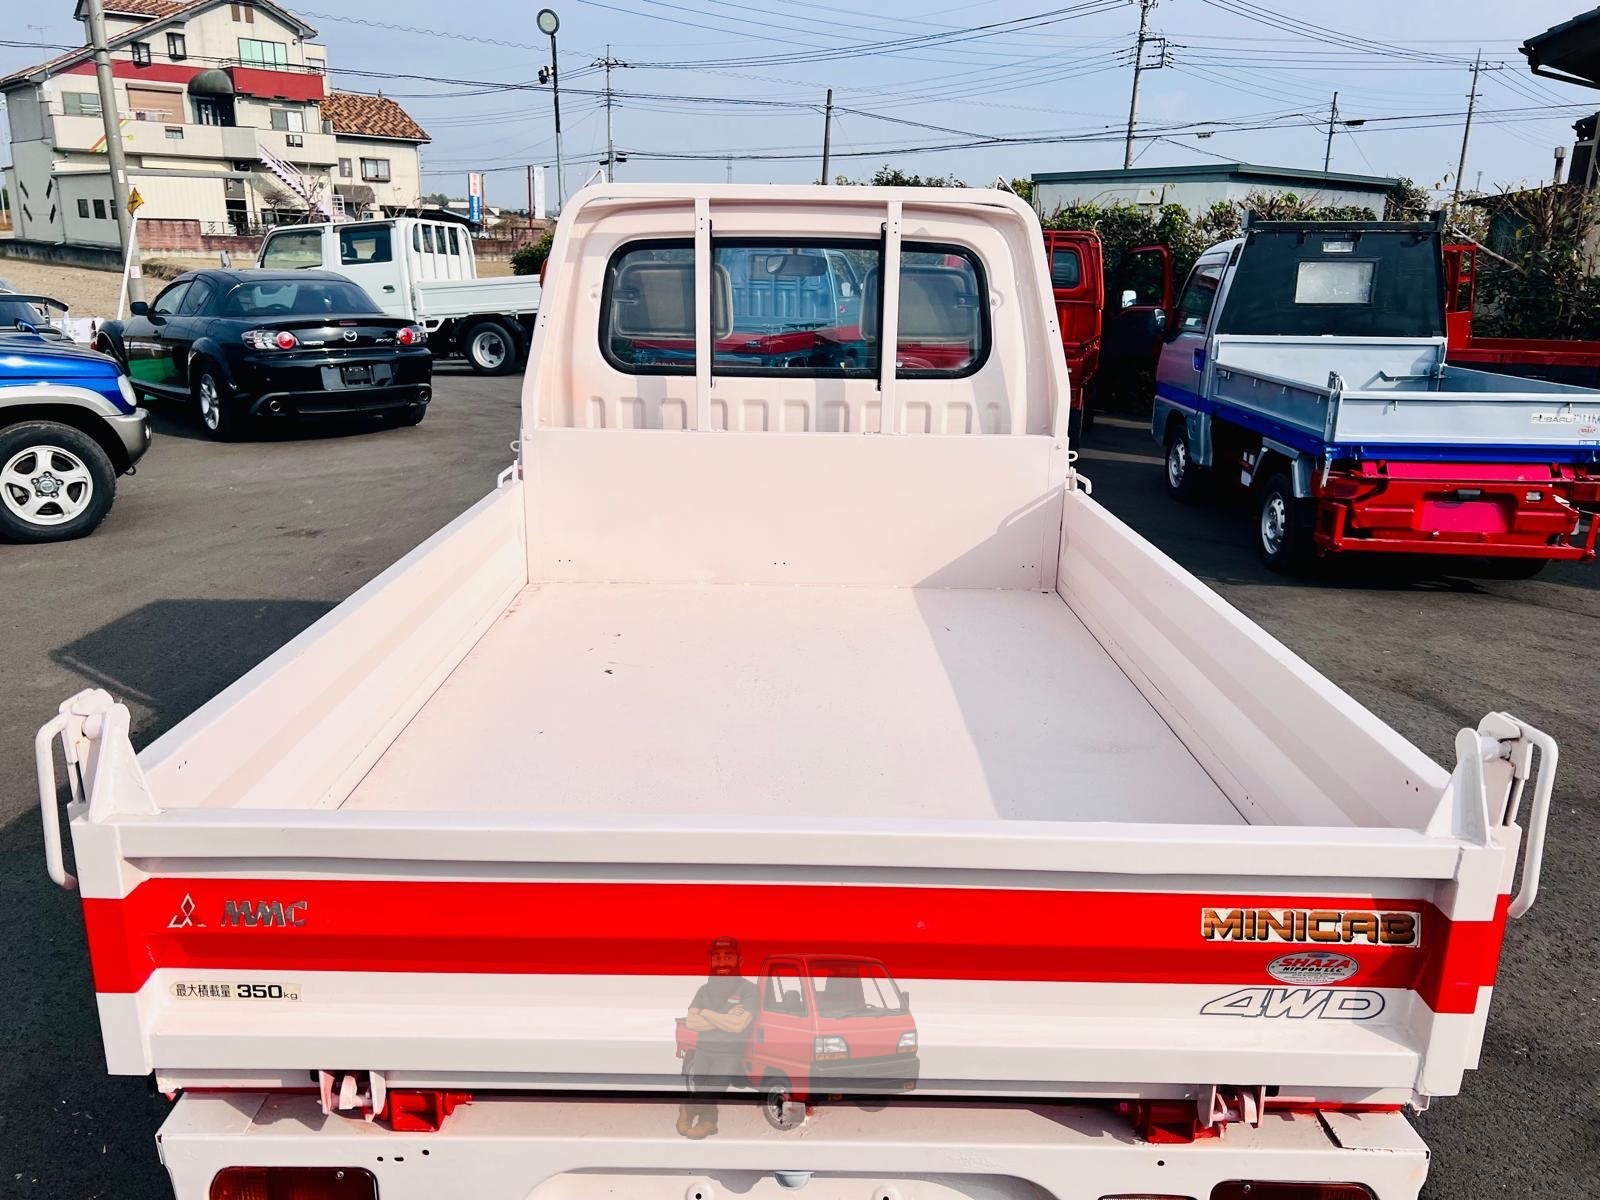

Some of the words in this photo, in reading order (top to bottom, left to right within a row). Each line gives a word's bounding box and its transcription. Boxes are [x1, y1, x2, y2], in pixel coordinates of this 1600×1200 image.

[220, 900, 308, 928] MMC
[1203, 909, 1416, 944] MINICAB
[1279, 958, 1351, 968] SHAZA
[176, 983, 231, 998] 最大積載量
[1200, 988, 1385, 1020] 4WD
